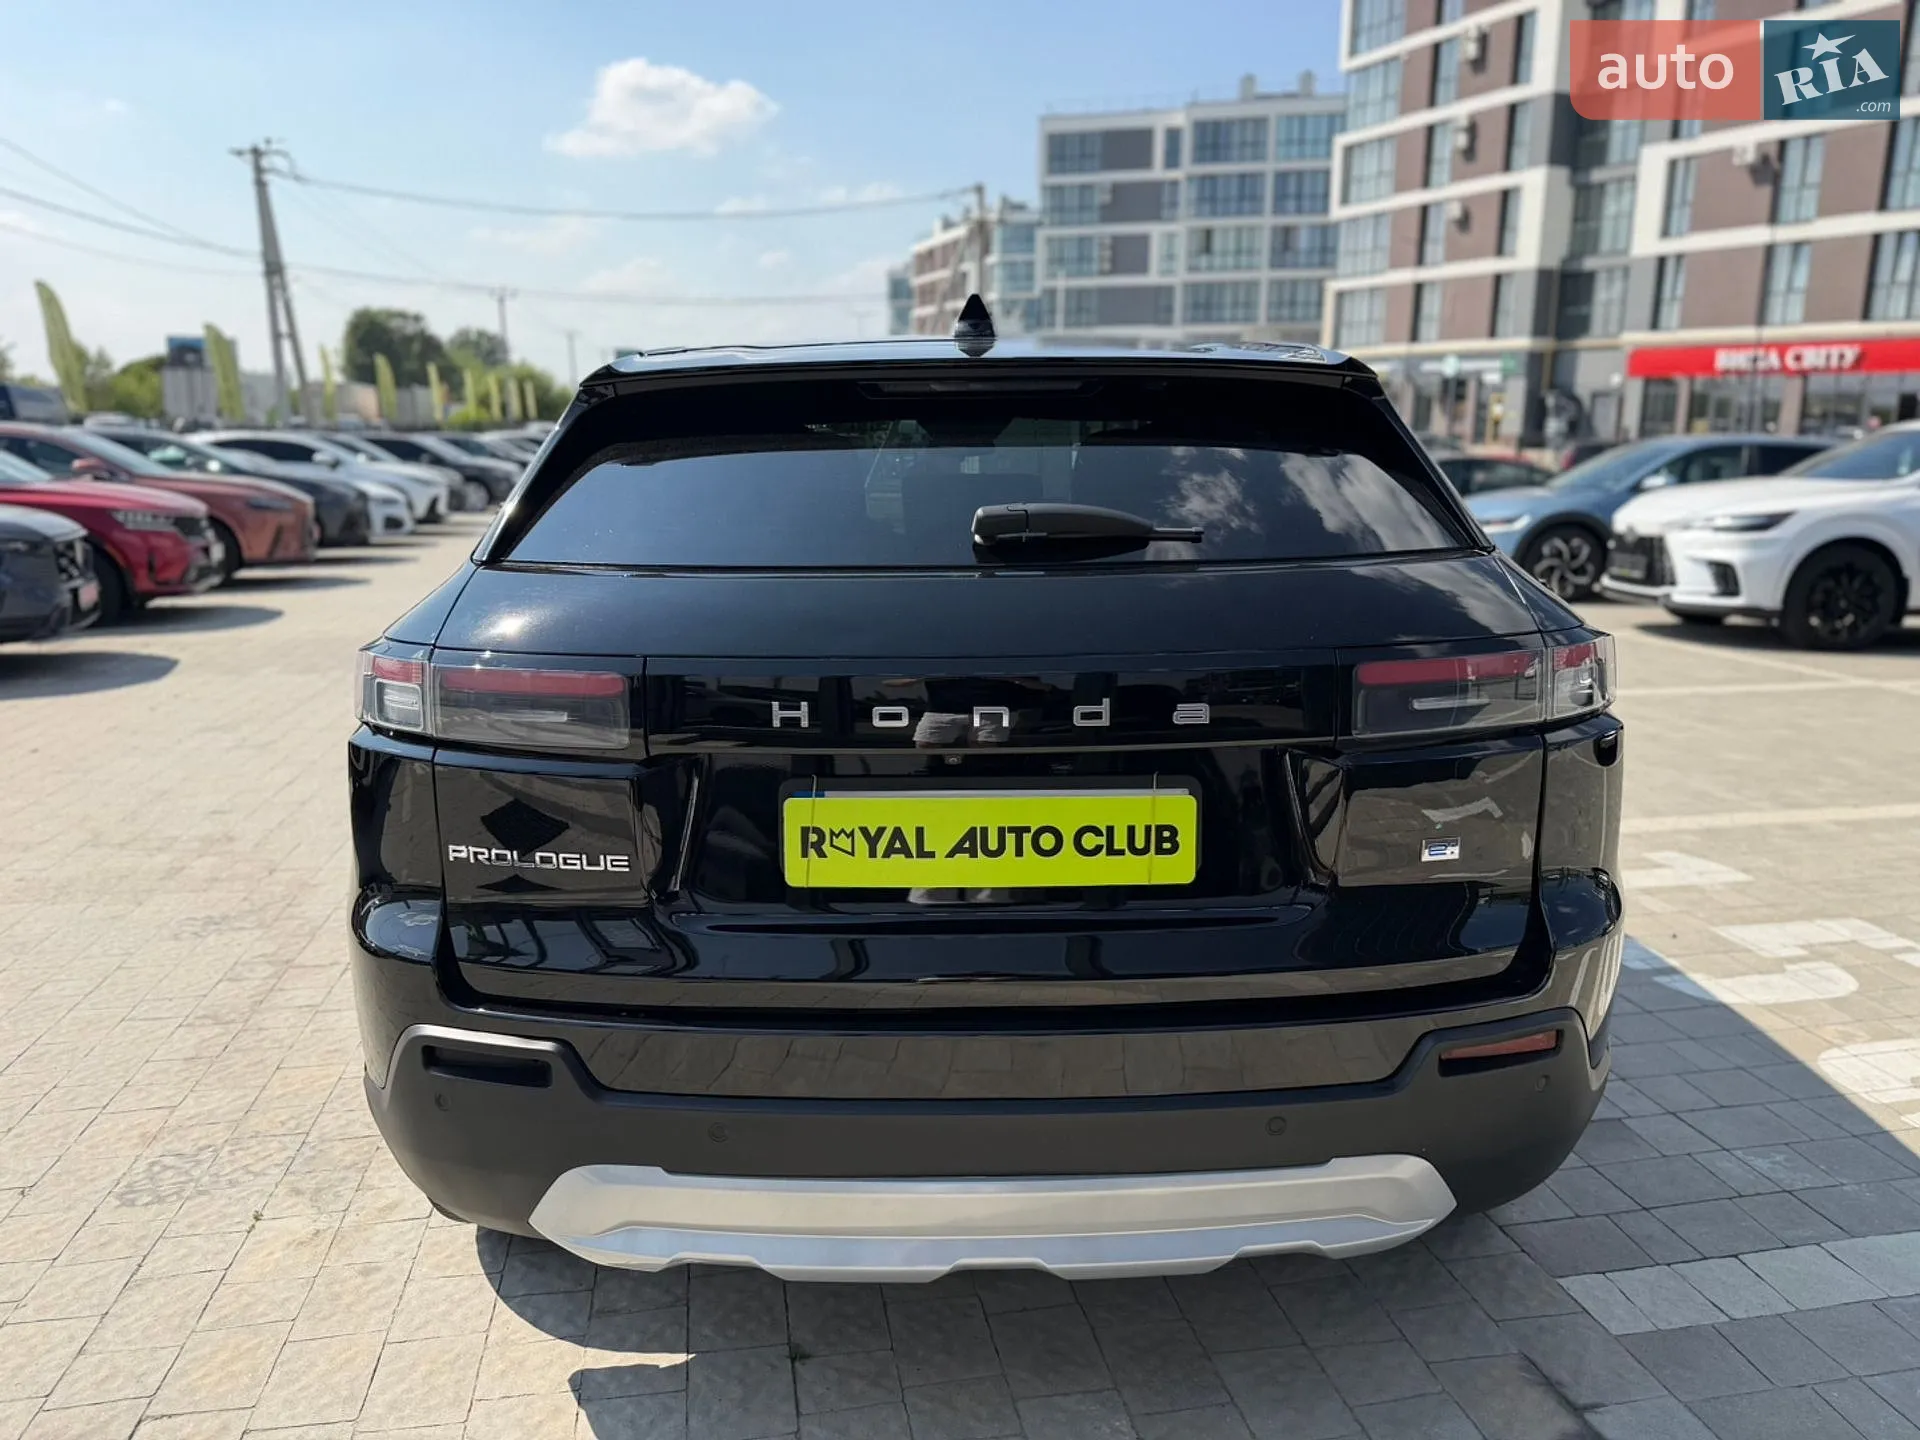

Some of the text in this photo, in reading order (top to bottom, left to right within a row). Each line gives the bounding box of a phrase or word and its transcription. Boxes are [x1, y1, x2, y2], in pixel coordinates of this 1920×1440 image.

[945, 824, 1064, 858] AUTO
[1072, 824, 1180, 857] CLUB
[448, 844, 630, 872] PROLOGUE
